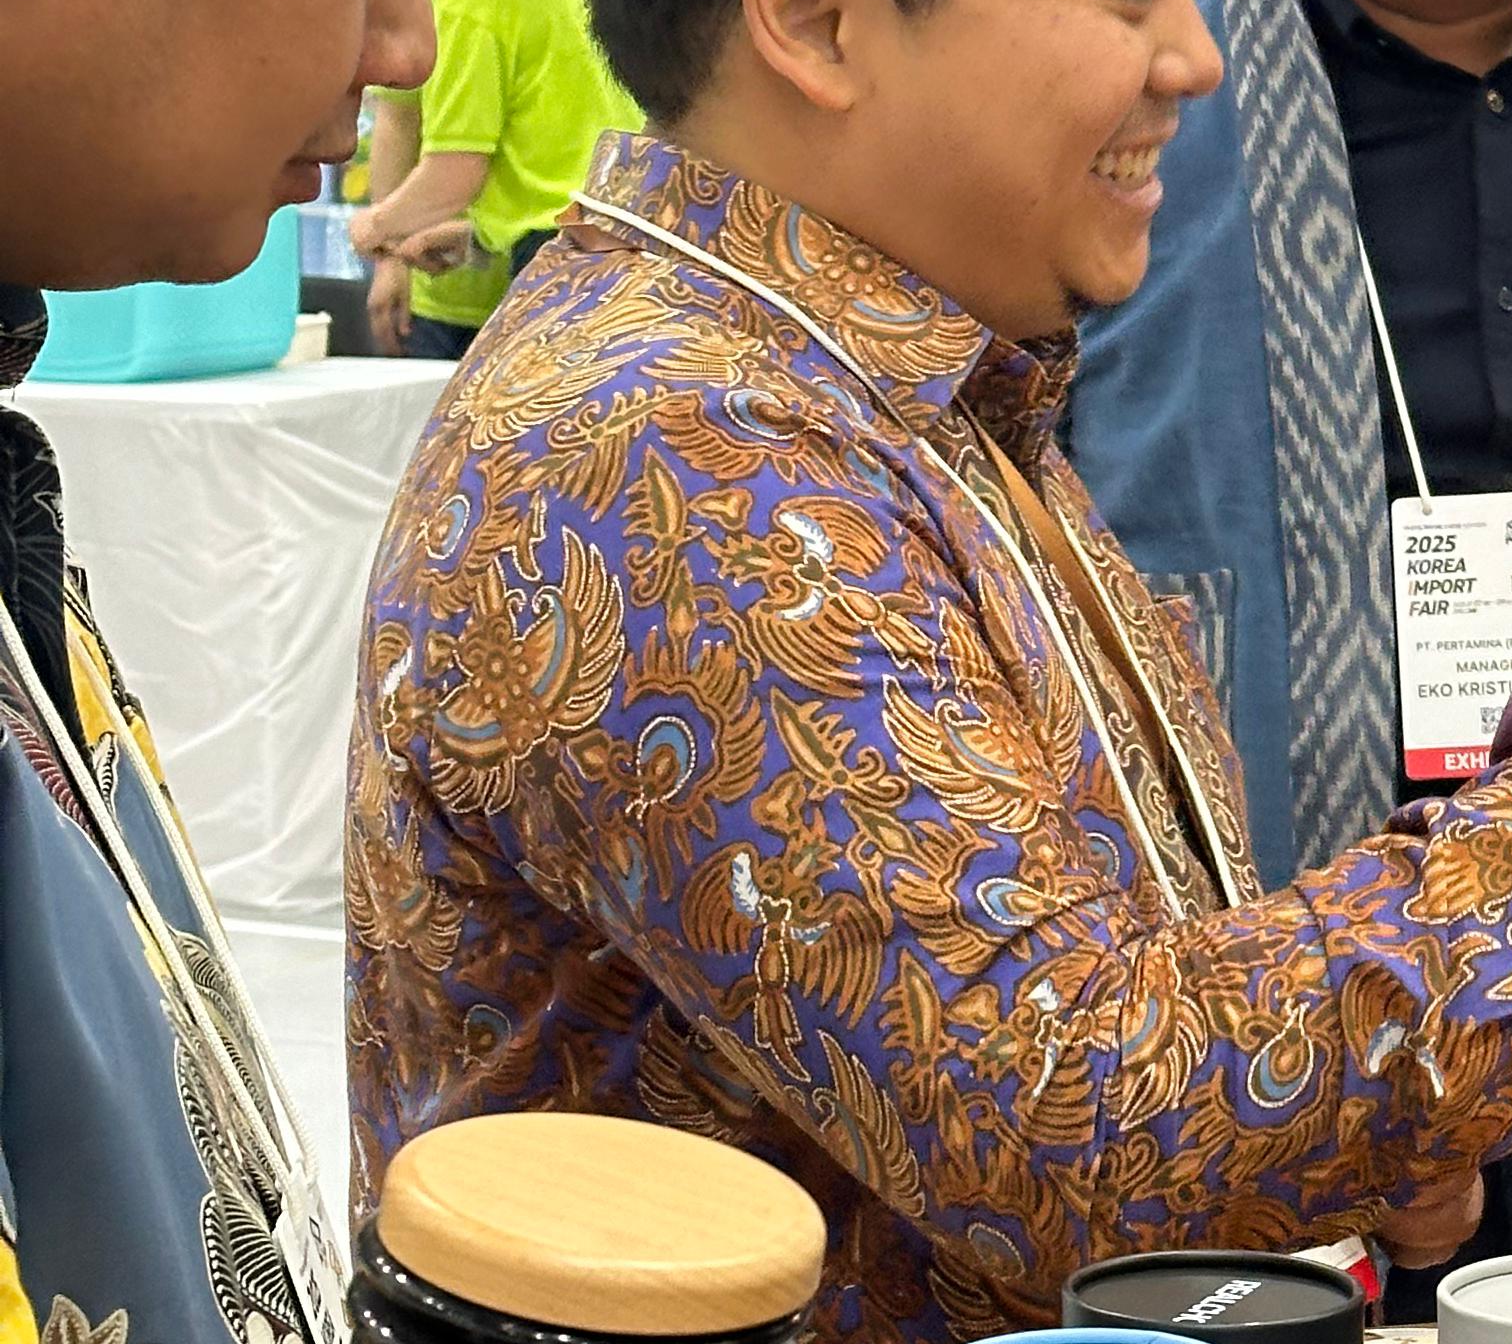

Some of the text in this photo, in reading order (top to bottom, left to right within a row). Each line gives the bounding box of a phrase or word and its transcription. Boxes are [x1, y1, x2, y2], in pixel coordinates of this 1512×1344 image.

[1404, 534, 1458, 555] 2025
[1406, 557, 1467, 575] KOREA
[1408, 577, 1477, 596] IMPORT
[1408, 599, 1450, 617] FAIR
[1418, 683, 1452, 698] EKO
[1444, 750, 1491, 771] EXHI
